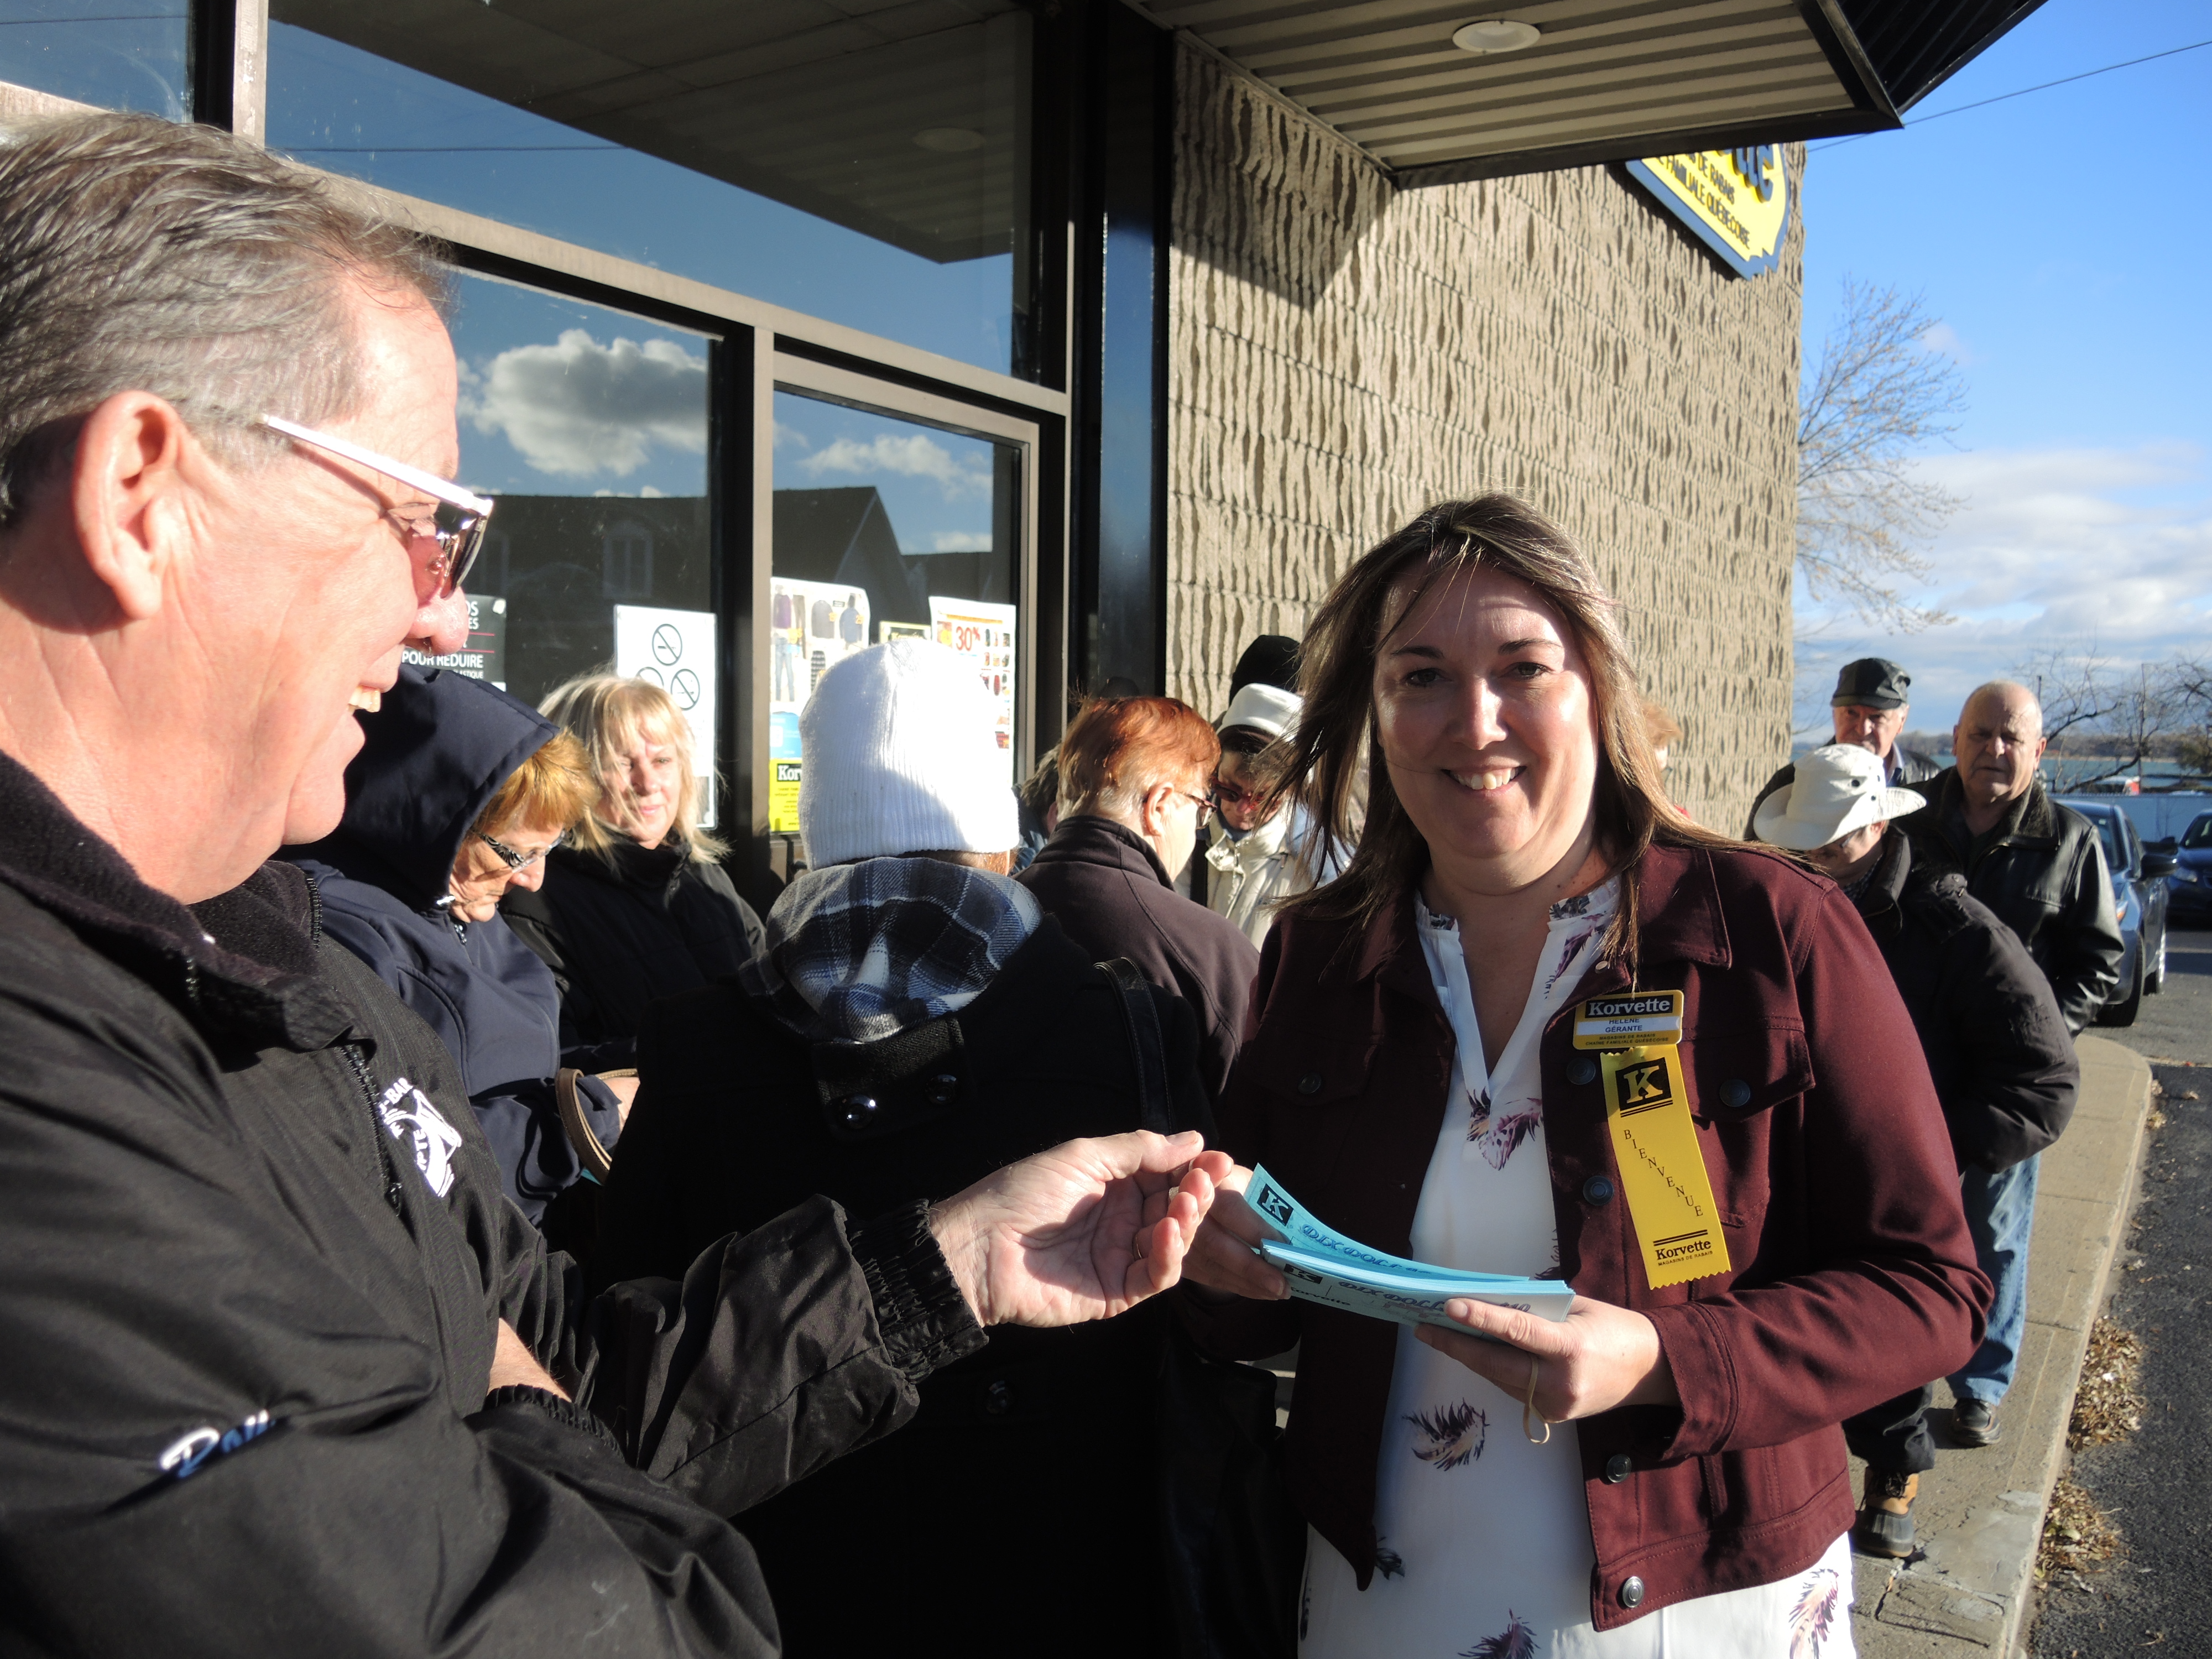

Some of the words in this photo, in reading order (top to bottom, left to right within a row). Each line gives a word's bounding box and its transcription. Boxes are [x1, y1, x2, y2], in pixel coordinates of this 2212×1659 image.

[402, 650, 434, 665] POUR
[1588, 998, 1670, 1016] Korvette
[1623, 1066, 1663, 1103] K
[1623, 1129, 1704, 1217] BIENVENUE
[1261, 1190, 1288, 1220] K
[1301, 1224, 1345, 1250] DIX
[1655, 1240, 1712, 1260] Korvette
[1658, 1257, 1684, 1266] MAGASINS
[1338, 1281, 1384, 1296] DIX
[1383, 1293, 1445, 1312] DOLL
